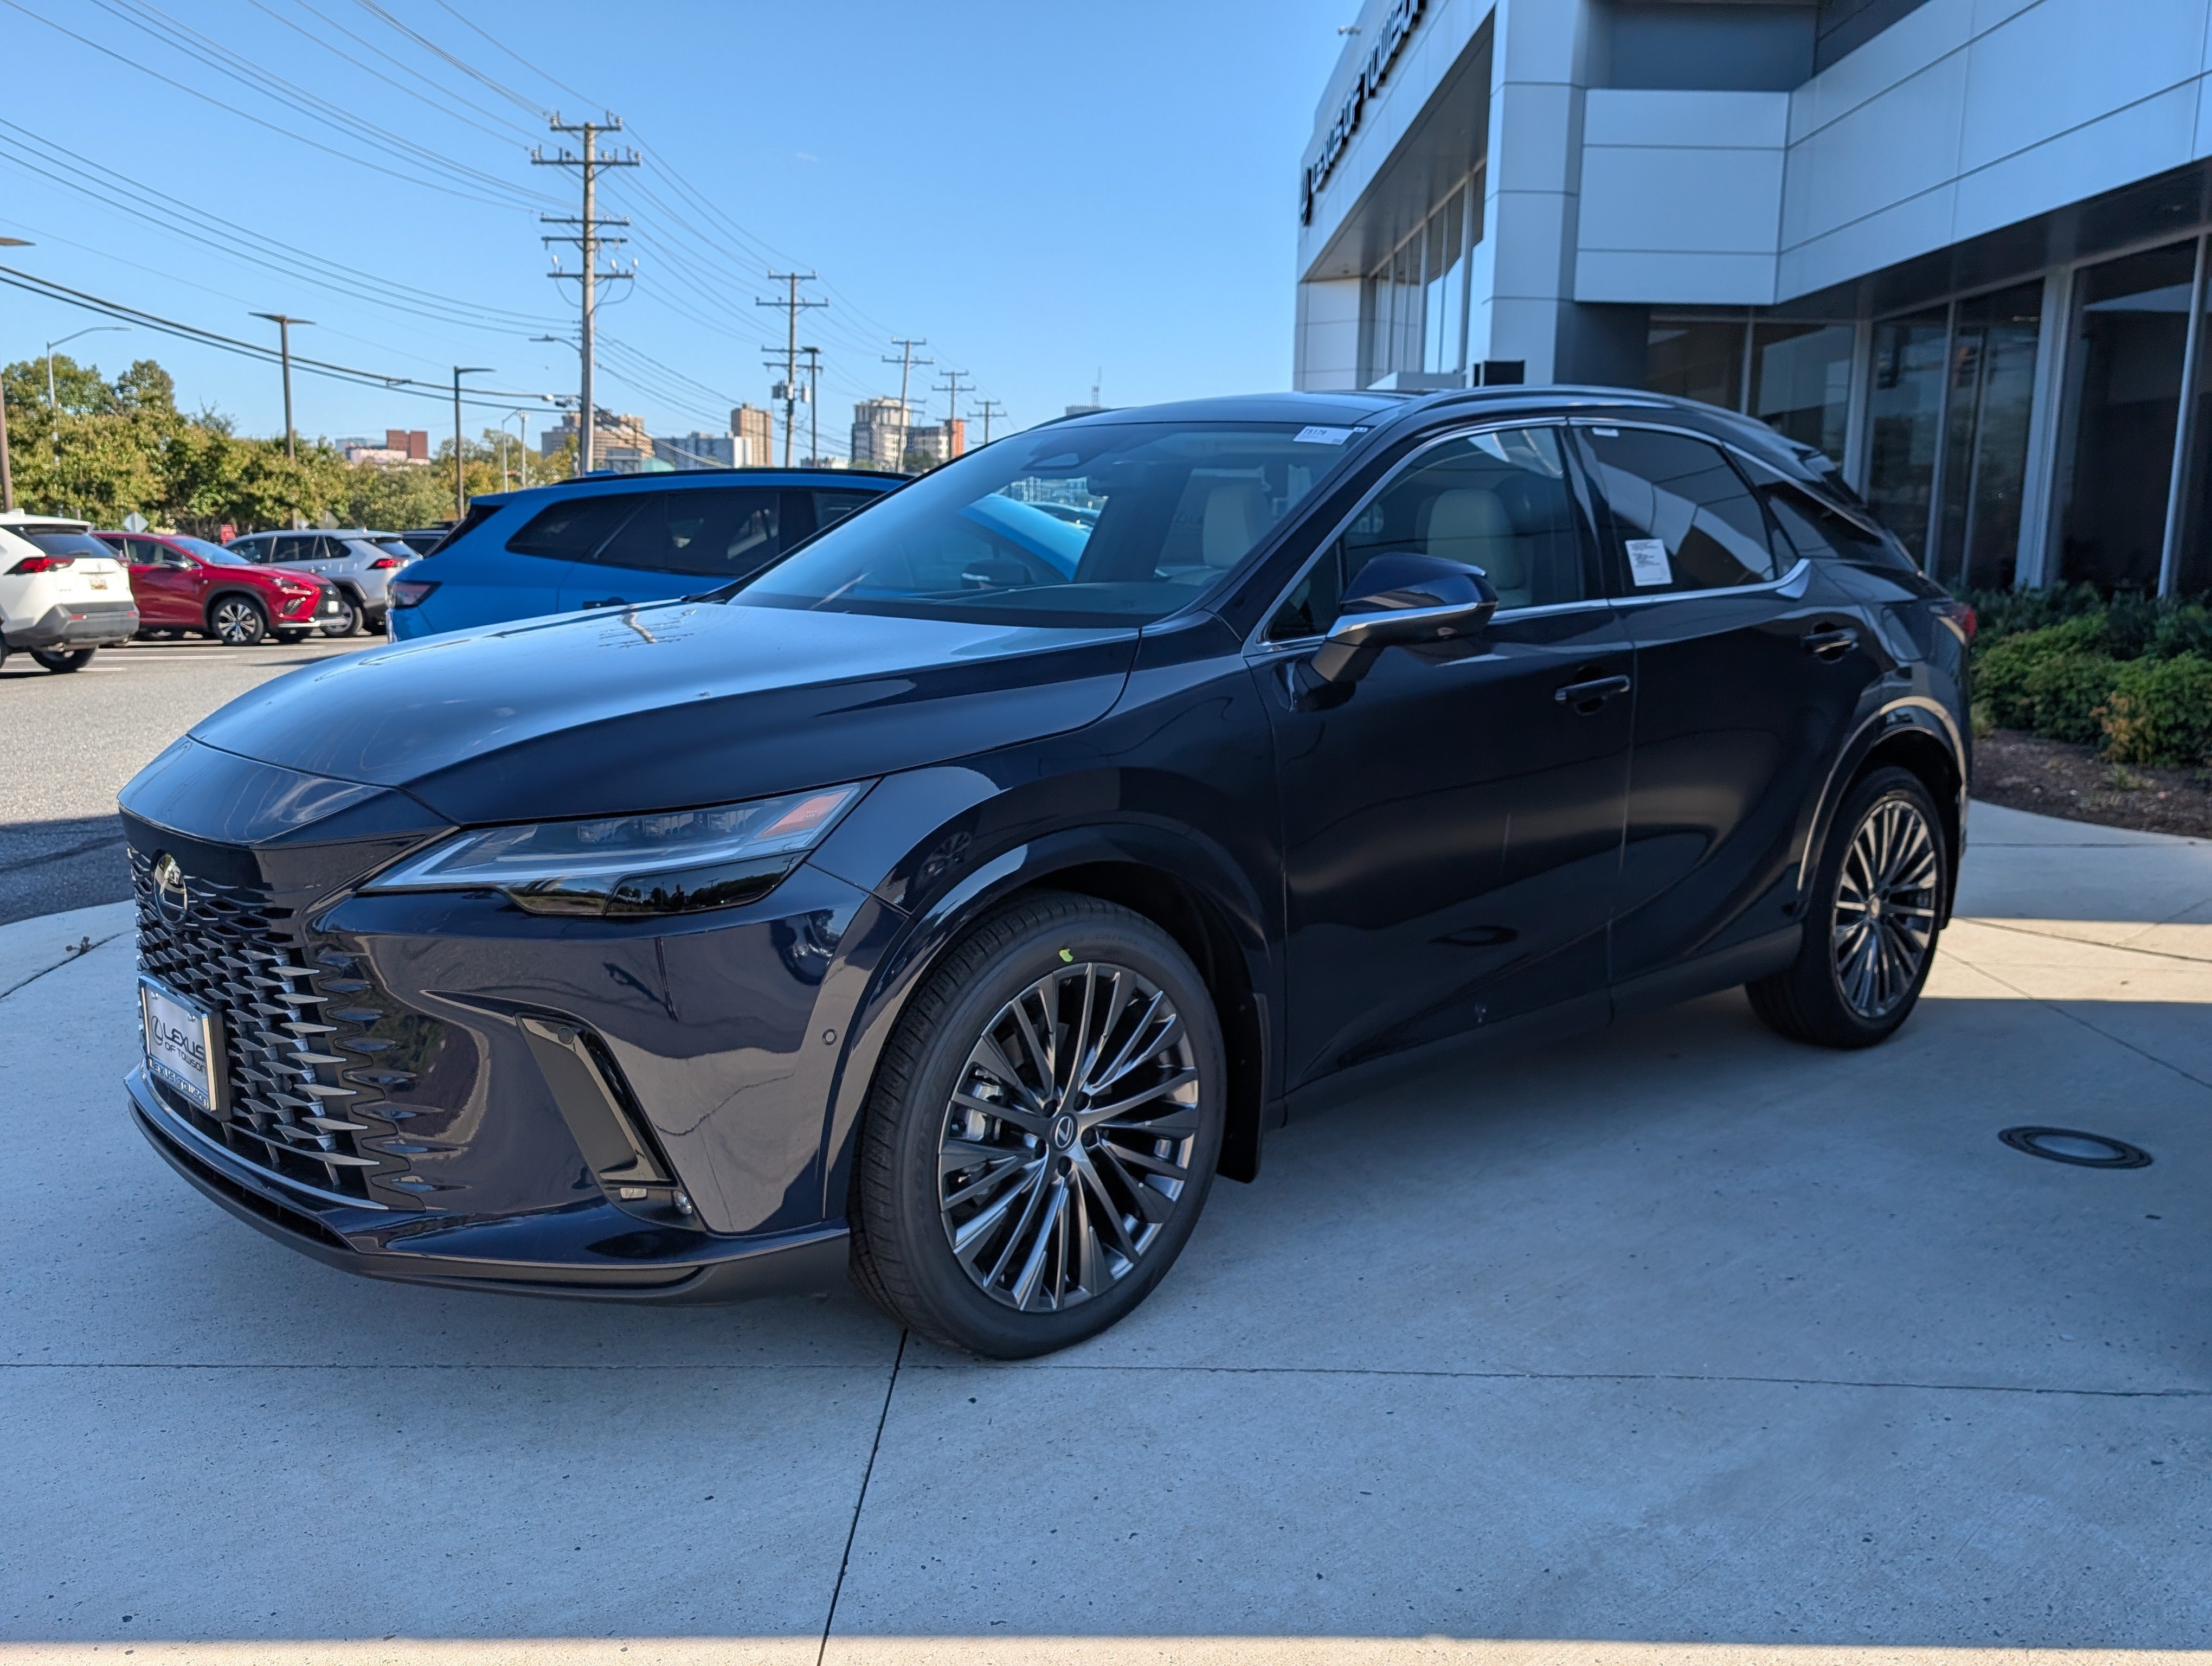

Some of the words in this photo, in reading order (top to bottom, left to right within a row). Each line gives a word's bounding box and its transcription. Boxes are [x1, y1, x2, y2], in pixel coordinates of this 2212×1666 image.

[163, 1022, 205, 1062] LEXUS
[165, 1042, 176, 1052] OF
[149, 1059, 176, 1082] LEXUS
